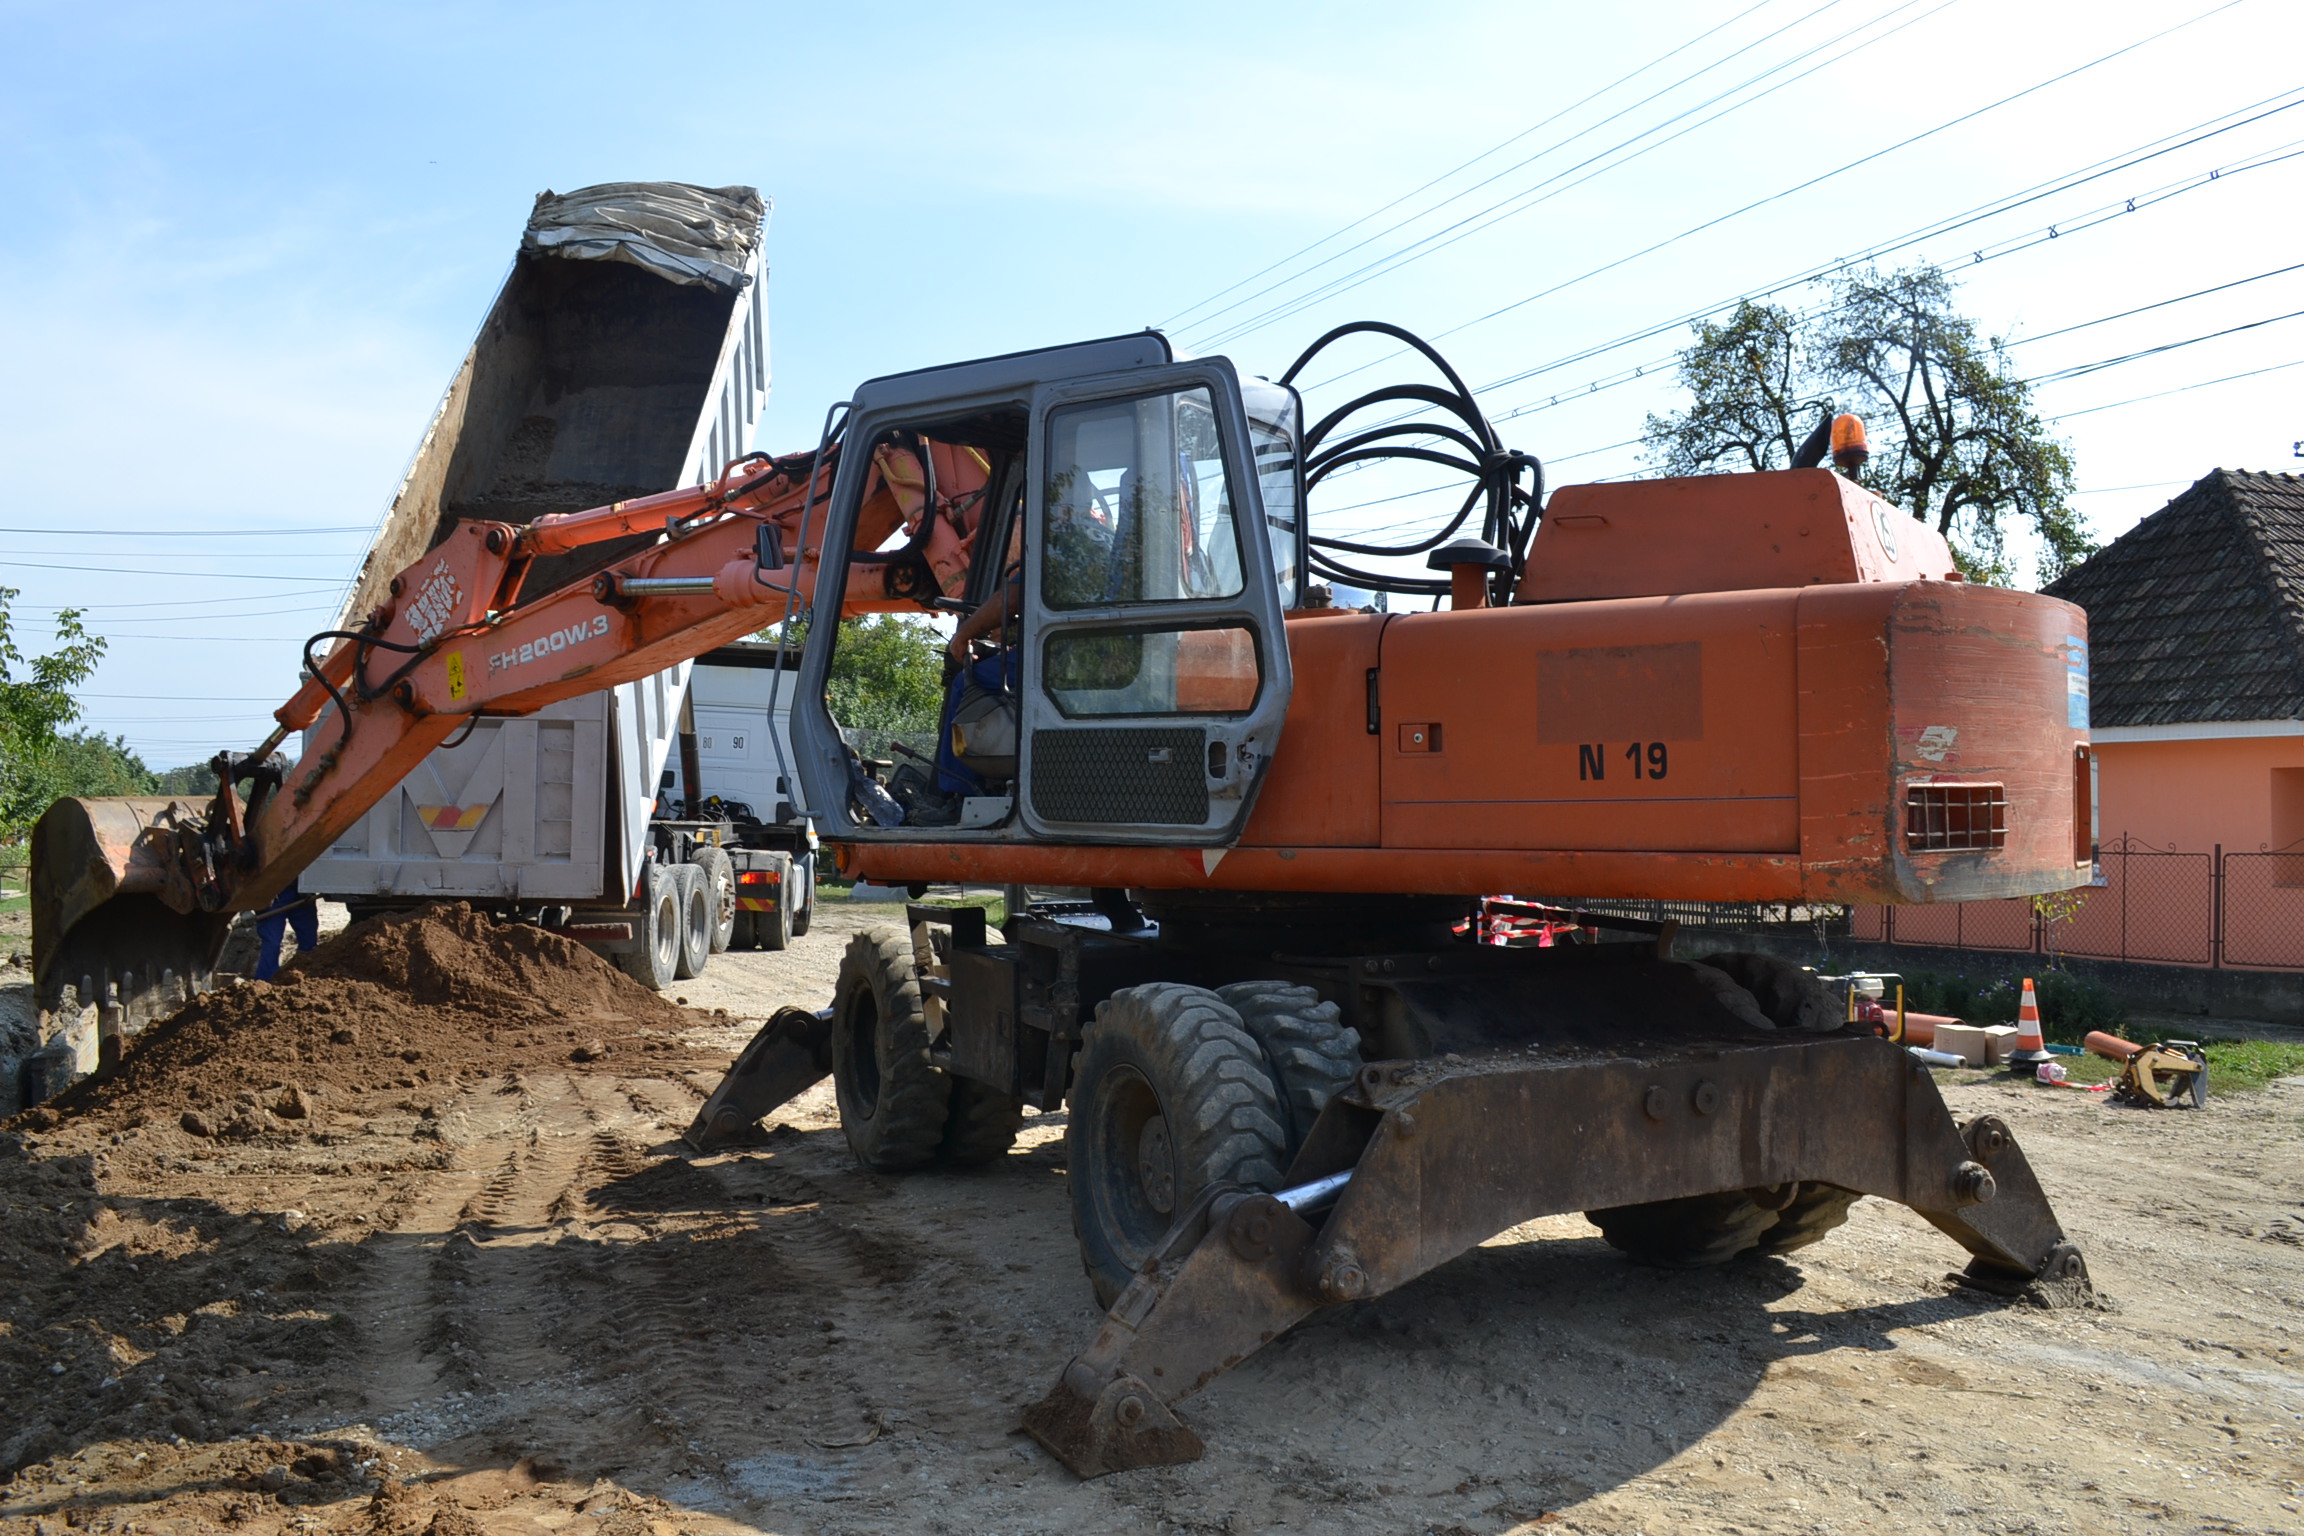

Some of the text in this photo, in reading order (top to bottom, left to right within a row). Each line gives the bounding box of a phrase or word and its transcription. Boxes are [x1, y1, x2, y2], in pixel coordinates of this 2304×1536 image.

[488, 615, 610, 675] FH200W.3
[733, 736, 744, 750] 90
[1579, 742, 1668, 781] N 19
